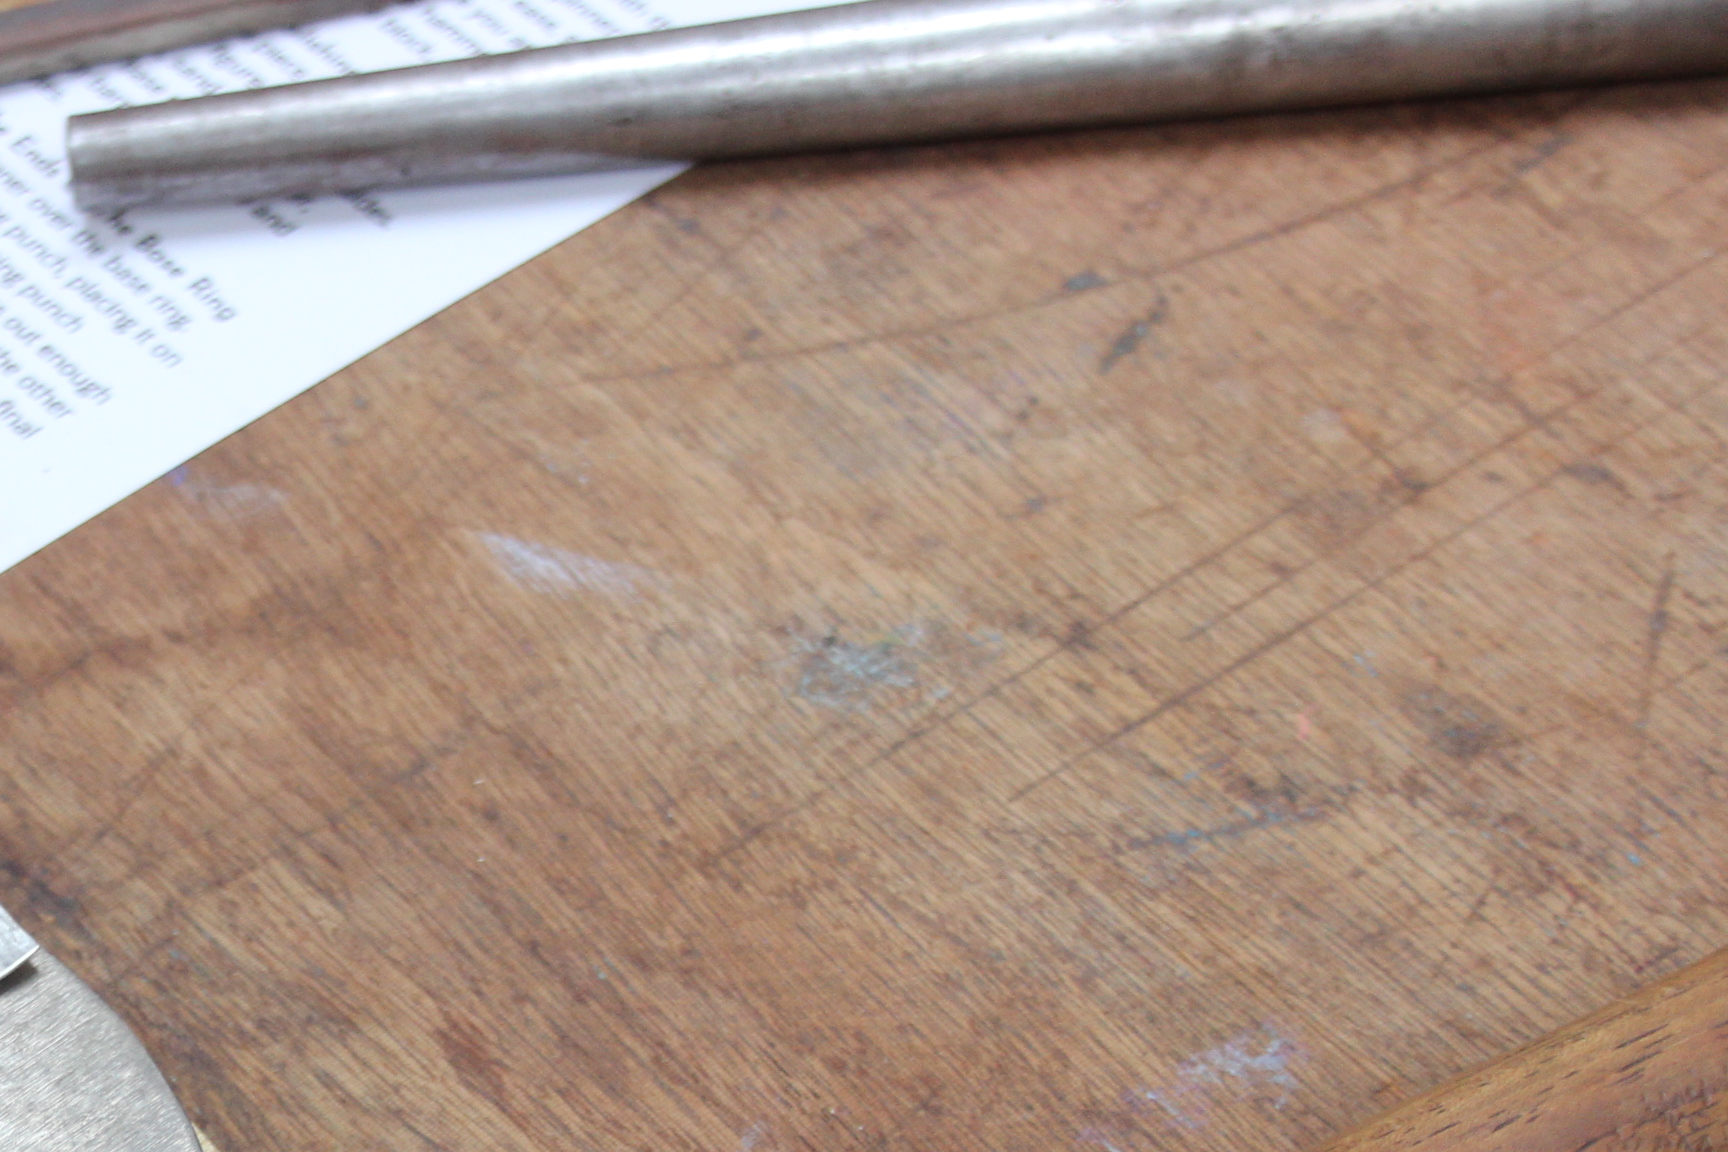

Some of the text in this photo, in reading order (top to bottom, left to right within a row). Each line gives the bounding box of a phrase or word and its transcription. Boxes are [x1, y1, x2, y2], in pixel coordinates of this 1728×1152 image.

[9, 133, 69, 179] Ends
[131, 230, 194, 281] Base
[185, 274, 237, 323] Ring
[29, 196, 77, 230] over
[68, 226, 112, 261] the
[100, 247, 151, 293] base
[14, 282, 84, 334] punch
[62, 274, 139, 335] placing
[148, 341, 183, 368] on
[1, 315, 43, 346] out
[35, 342, 111, 405] enough
[16, 373, 74, 418] other
